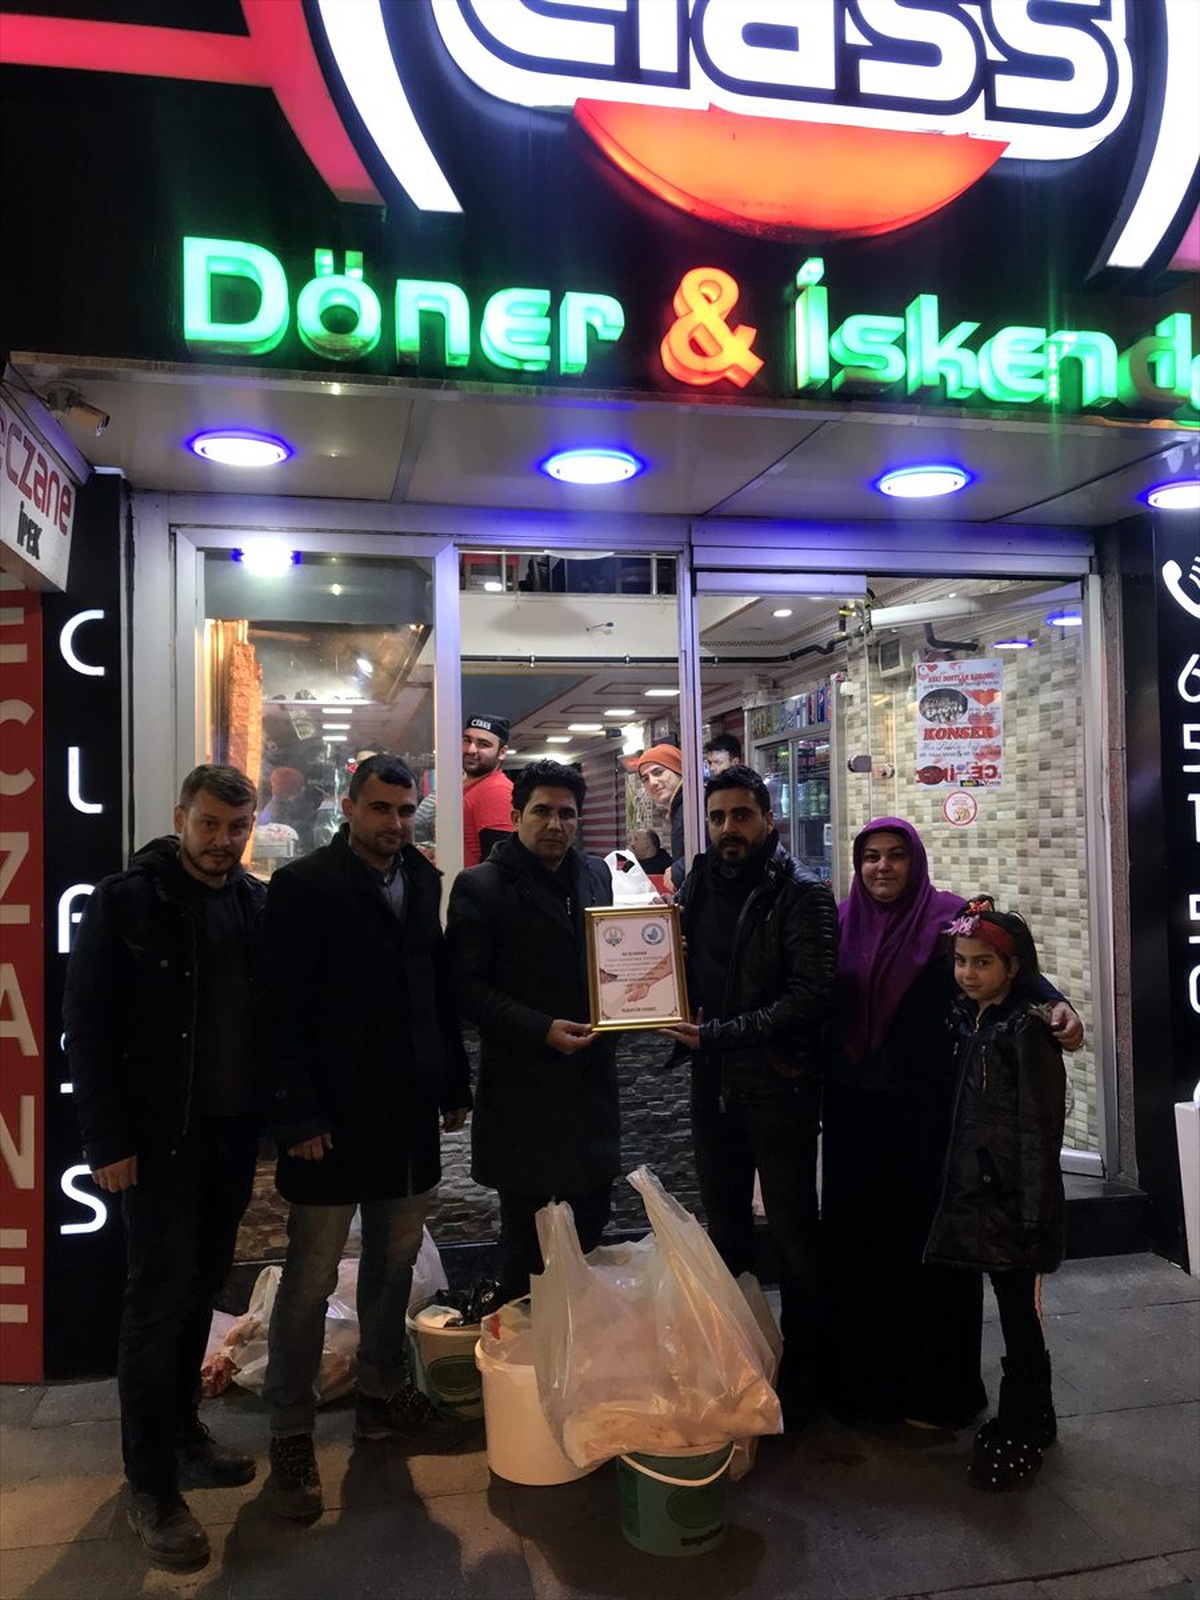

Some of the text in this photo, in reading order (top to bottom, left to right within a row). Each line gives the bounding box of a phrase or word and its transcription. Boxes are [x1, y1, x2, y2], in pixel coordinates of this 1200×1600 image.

[183, 236, 1200, 413] Döner & İskend
[57, 609, 108, 1235] CLAS
